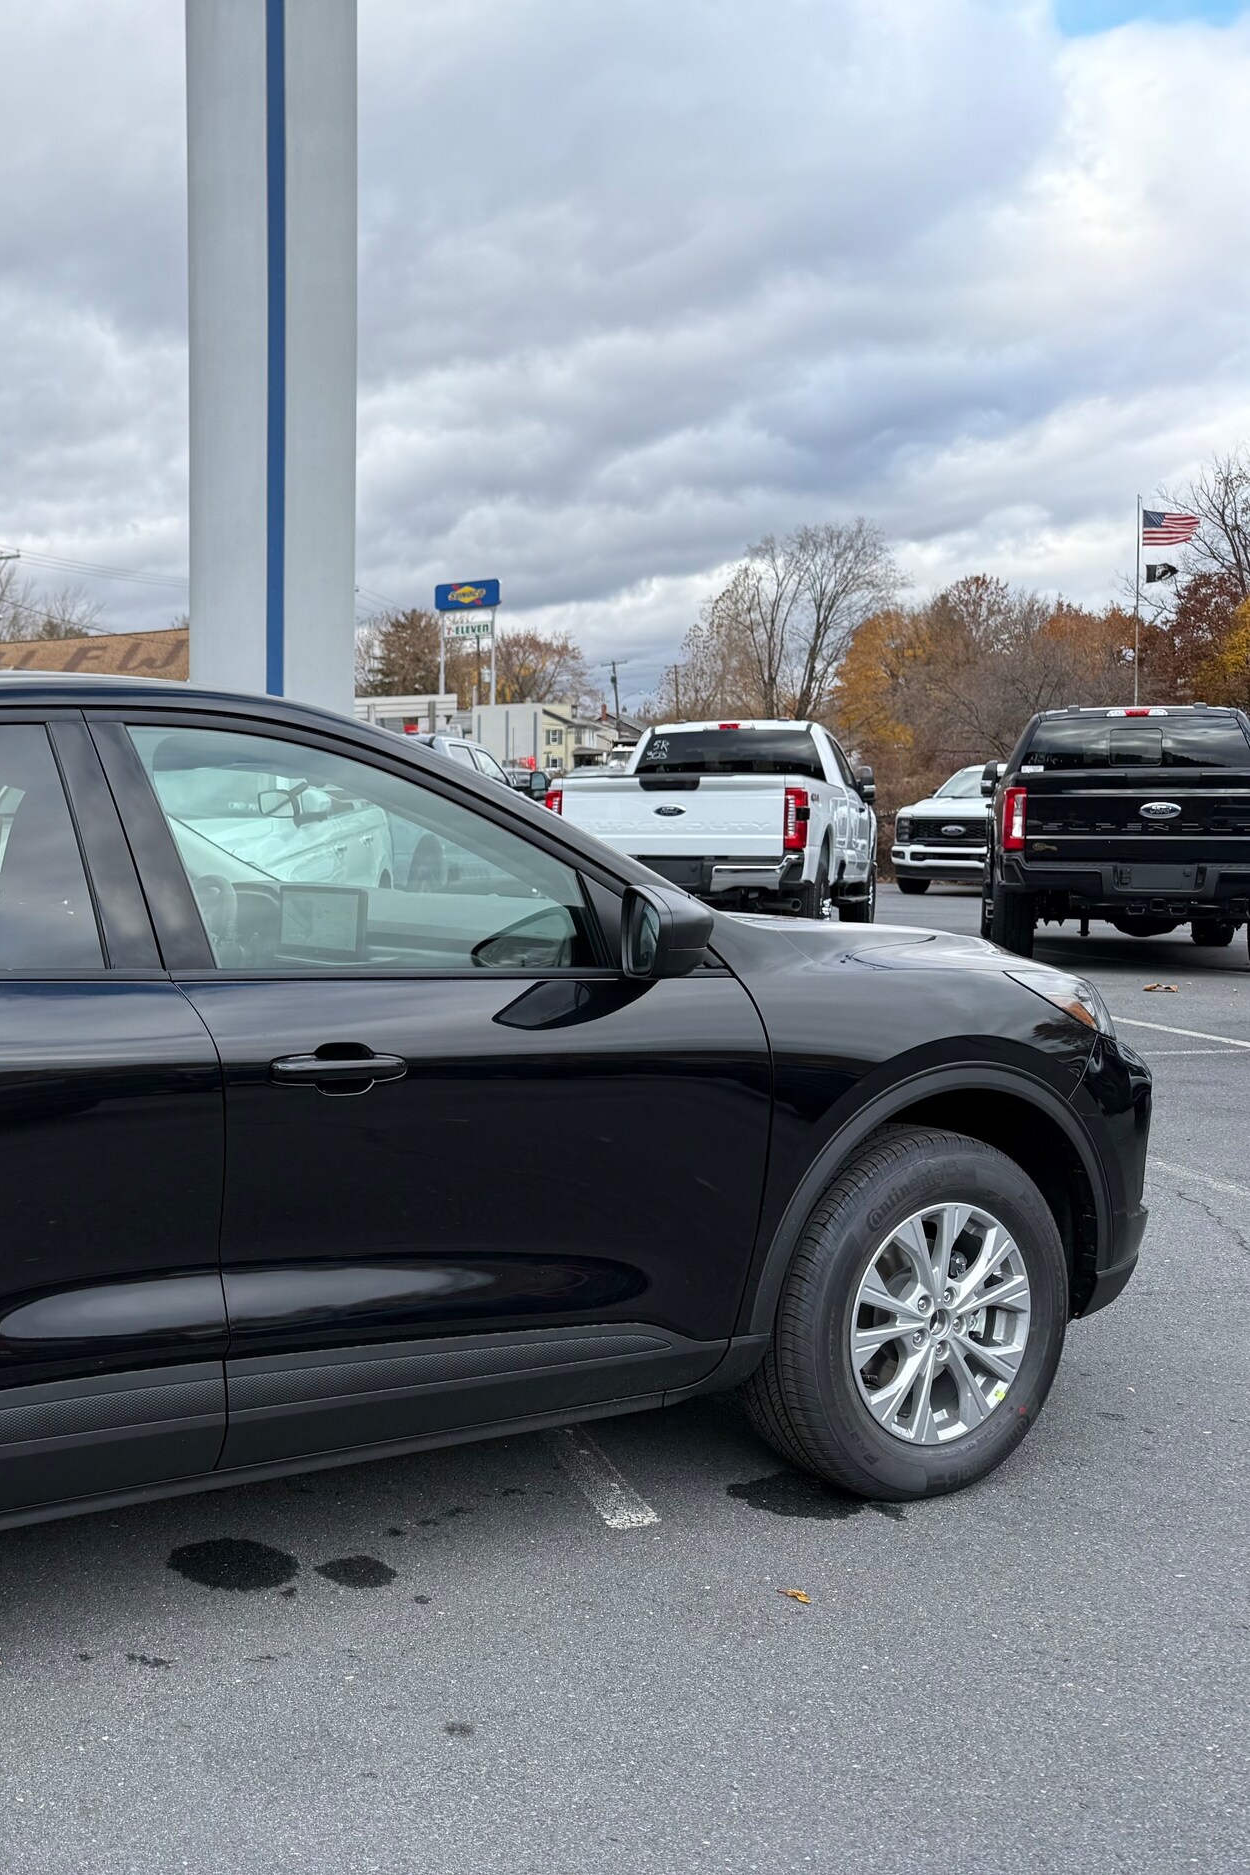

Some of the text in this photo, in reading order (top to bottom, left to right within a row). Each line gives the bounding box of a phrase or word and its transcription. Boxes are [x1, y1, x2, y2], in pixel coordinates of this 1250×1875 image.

[1150, 804, 1172, 814] Ford
[691, 820, 771, 832] DUTY
[1042, 822, 1170, 831] SUPER
